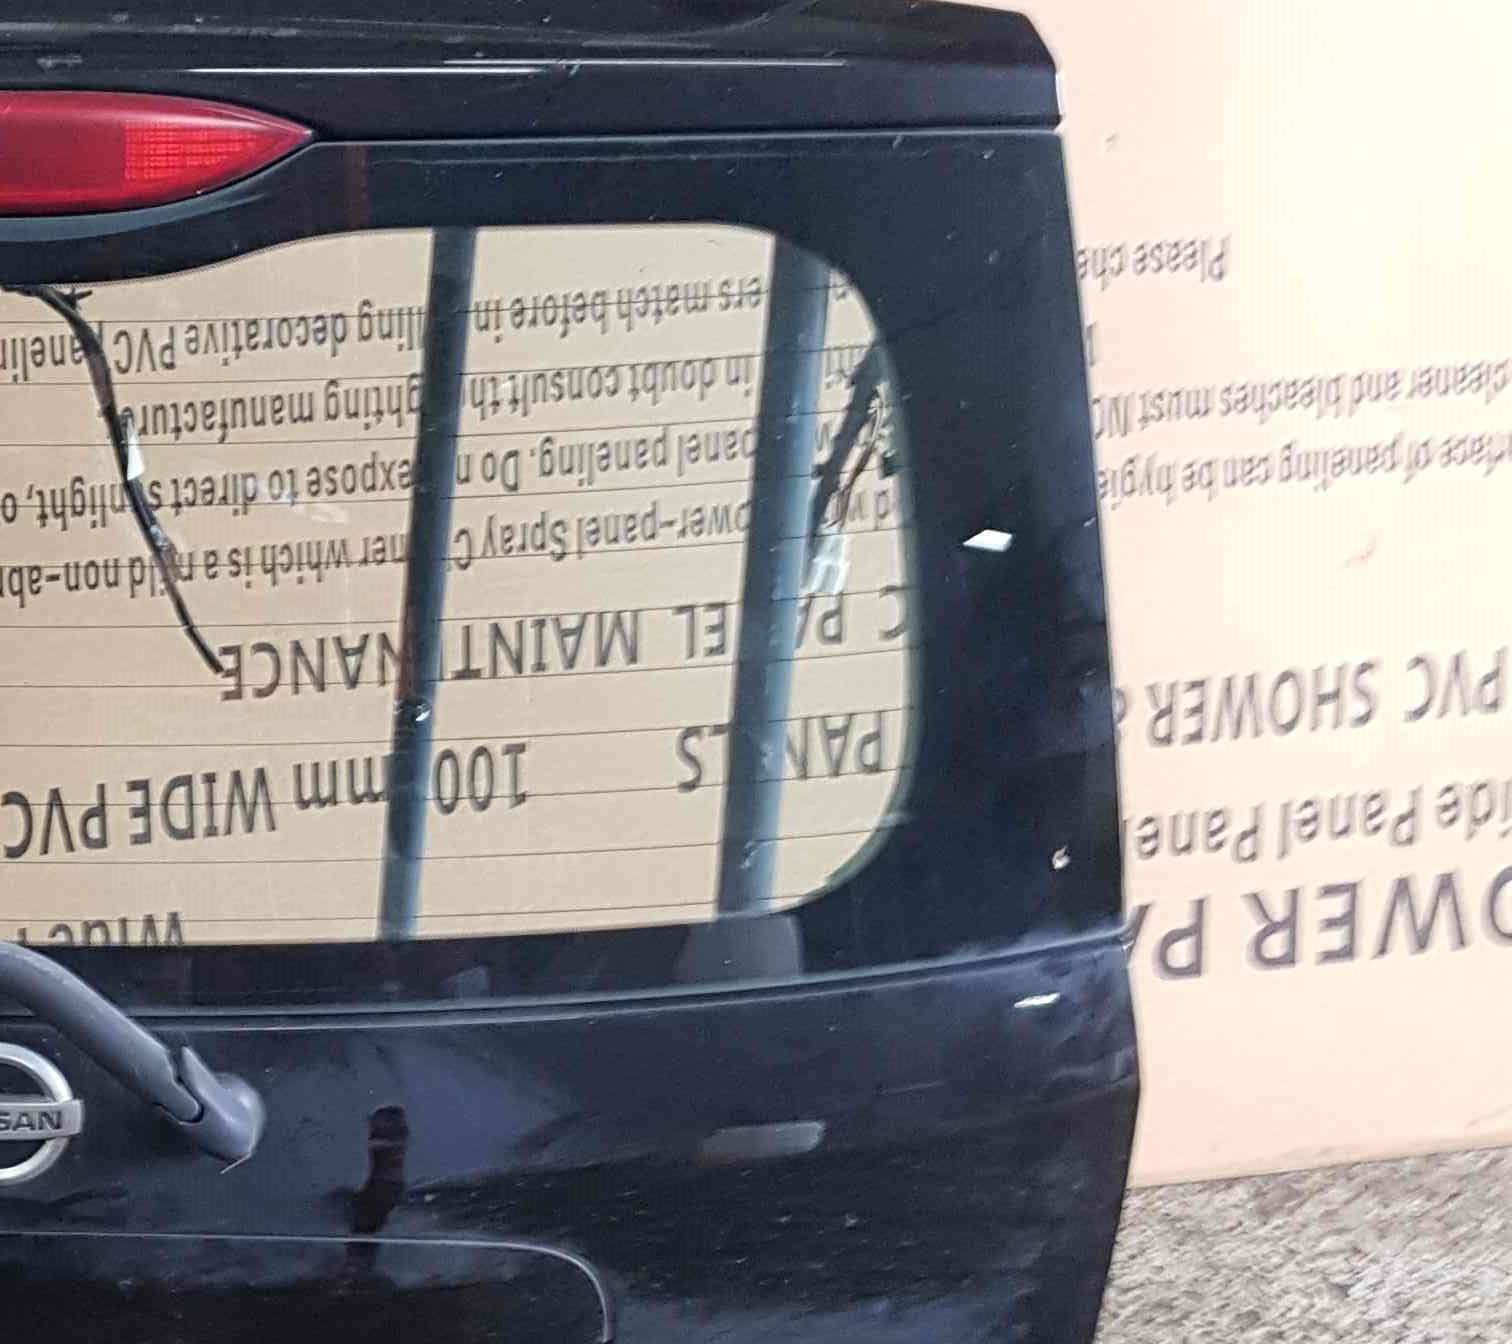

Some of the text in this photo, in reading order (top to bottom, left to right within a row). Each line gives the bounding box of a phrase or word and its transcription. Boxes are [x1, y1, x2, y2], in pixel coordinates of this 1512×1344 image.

[1077, 239, 1126, 291] che
[1133, 231, 1231, 284] Please
[510, 289, 606, 339] before
[616, 281, 709, 333] match
[113, 324, 175, 374] PVC
[185, 312, 347, 367] decorative
[325, 374, 422, 428] ghting
[470, 376, 501, 420] th
[507, 366, 619, 418] consult
[628, 358, 716, 406] doubt
[726, 356, 752, 397] in
[1220, 374, 1348, 425] bleaches
[1348, 366, 1405, 418] and
[1409, 358, 1511, 406] cleaner
[1091, 392, 1137, 440] NO
[1139, 384, 1219, 430] must
[305, 450, 413, 498] expose
[485, 453, 520, 493] Do
[529, 430, 669, 489] paneling.
[1098, 452, 1180, 511] hygie
[1182, 456, 1223, 503] be
[1224, 452, 1275, 489] can
[1277, 432, 1405, 495] paneling
[1403, 433, 1433, 484] of
[26, 476, 163, 531] snlight,
[174, 468, 258, 517] direct
[269, 466, 298, 507] to
[485, 508, 570, 562] Spray
[575, 492, 753, 560] ower-panel
[205, 547, 219, 567] a
[227, 546, 252, 589] is
[261, 537, 349, 587] which
[219, 609, 640, 701] MAINTNANCE
[1144, 659, 1382, 748] SHOWER
[1403, 643, 1510, 724] PVC
[1, 782, 108, 859] PVC
[127, 767, 276, 845] WIDE
[1128, 776, 1512, 864] ide Panel Pane
